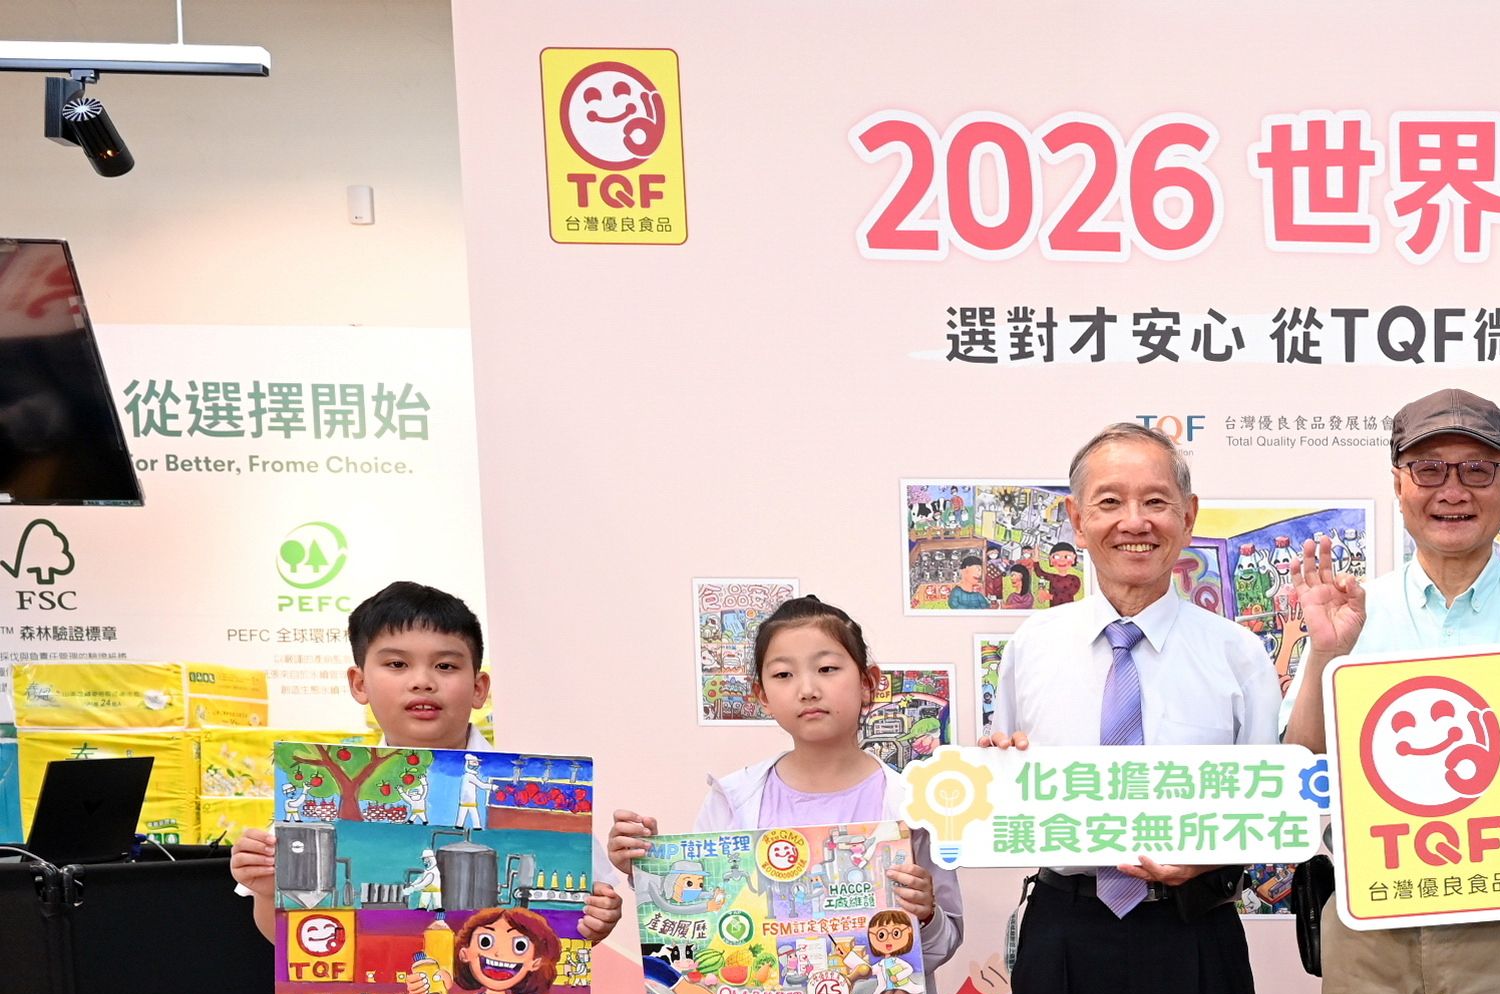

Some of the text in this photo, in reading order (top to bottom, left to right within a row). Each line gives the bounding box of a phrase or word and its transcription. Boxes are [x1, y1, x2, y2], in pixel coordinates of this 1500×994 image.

[566, 173, 667, 209] TQF
[857, 117, 1216, 255] 2026
[564, 215, 673, 234] 台灣優良食品
[945, 305, 1246, 366] 選對才安心
[123, 379, 431, 441] 從選擇開始
[1226, 436, 1393, 450] Total Quality Food Associatio
[134, 454, 414, 475] or Better, Frome Choice.
[16, 590, 78, 612] FSC
[277, 595, 352, 612] PEFC
[19, 625, 118, 642] 森林驗證標章
[227, 629, 270, 642] PEFC
[1015, 759, 1286, 802] 化負擔為解方
[992, 810, 1310, 855] 讓食安無所不在
[829, 882, 872, 895] HACCP
[289, 960, 346, 980] TQF
